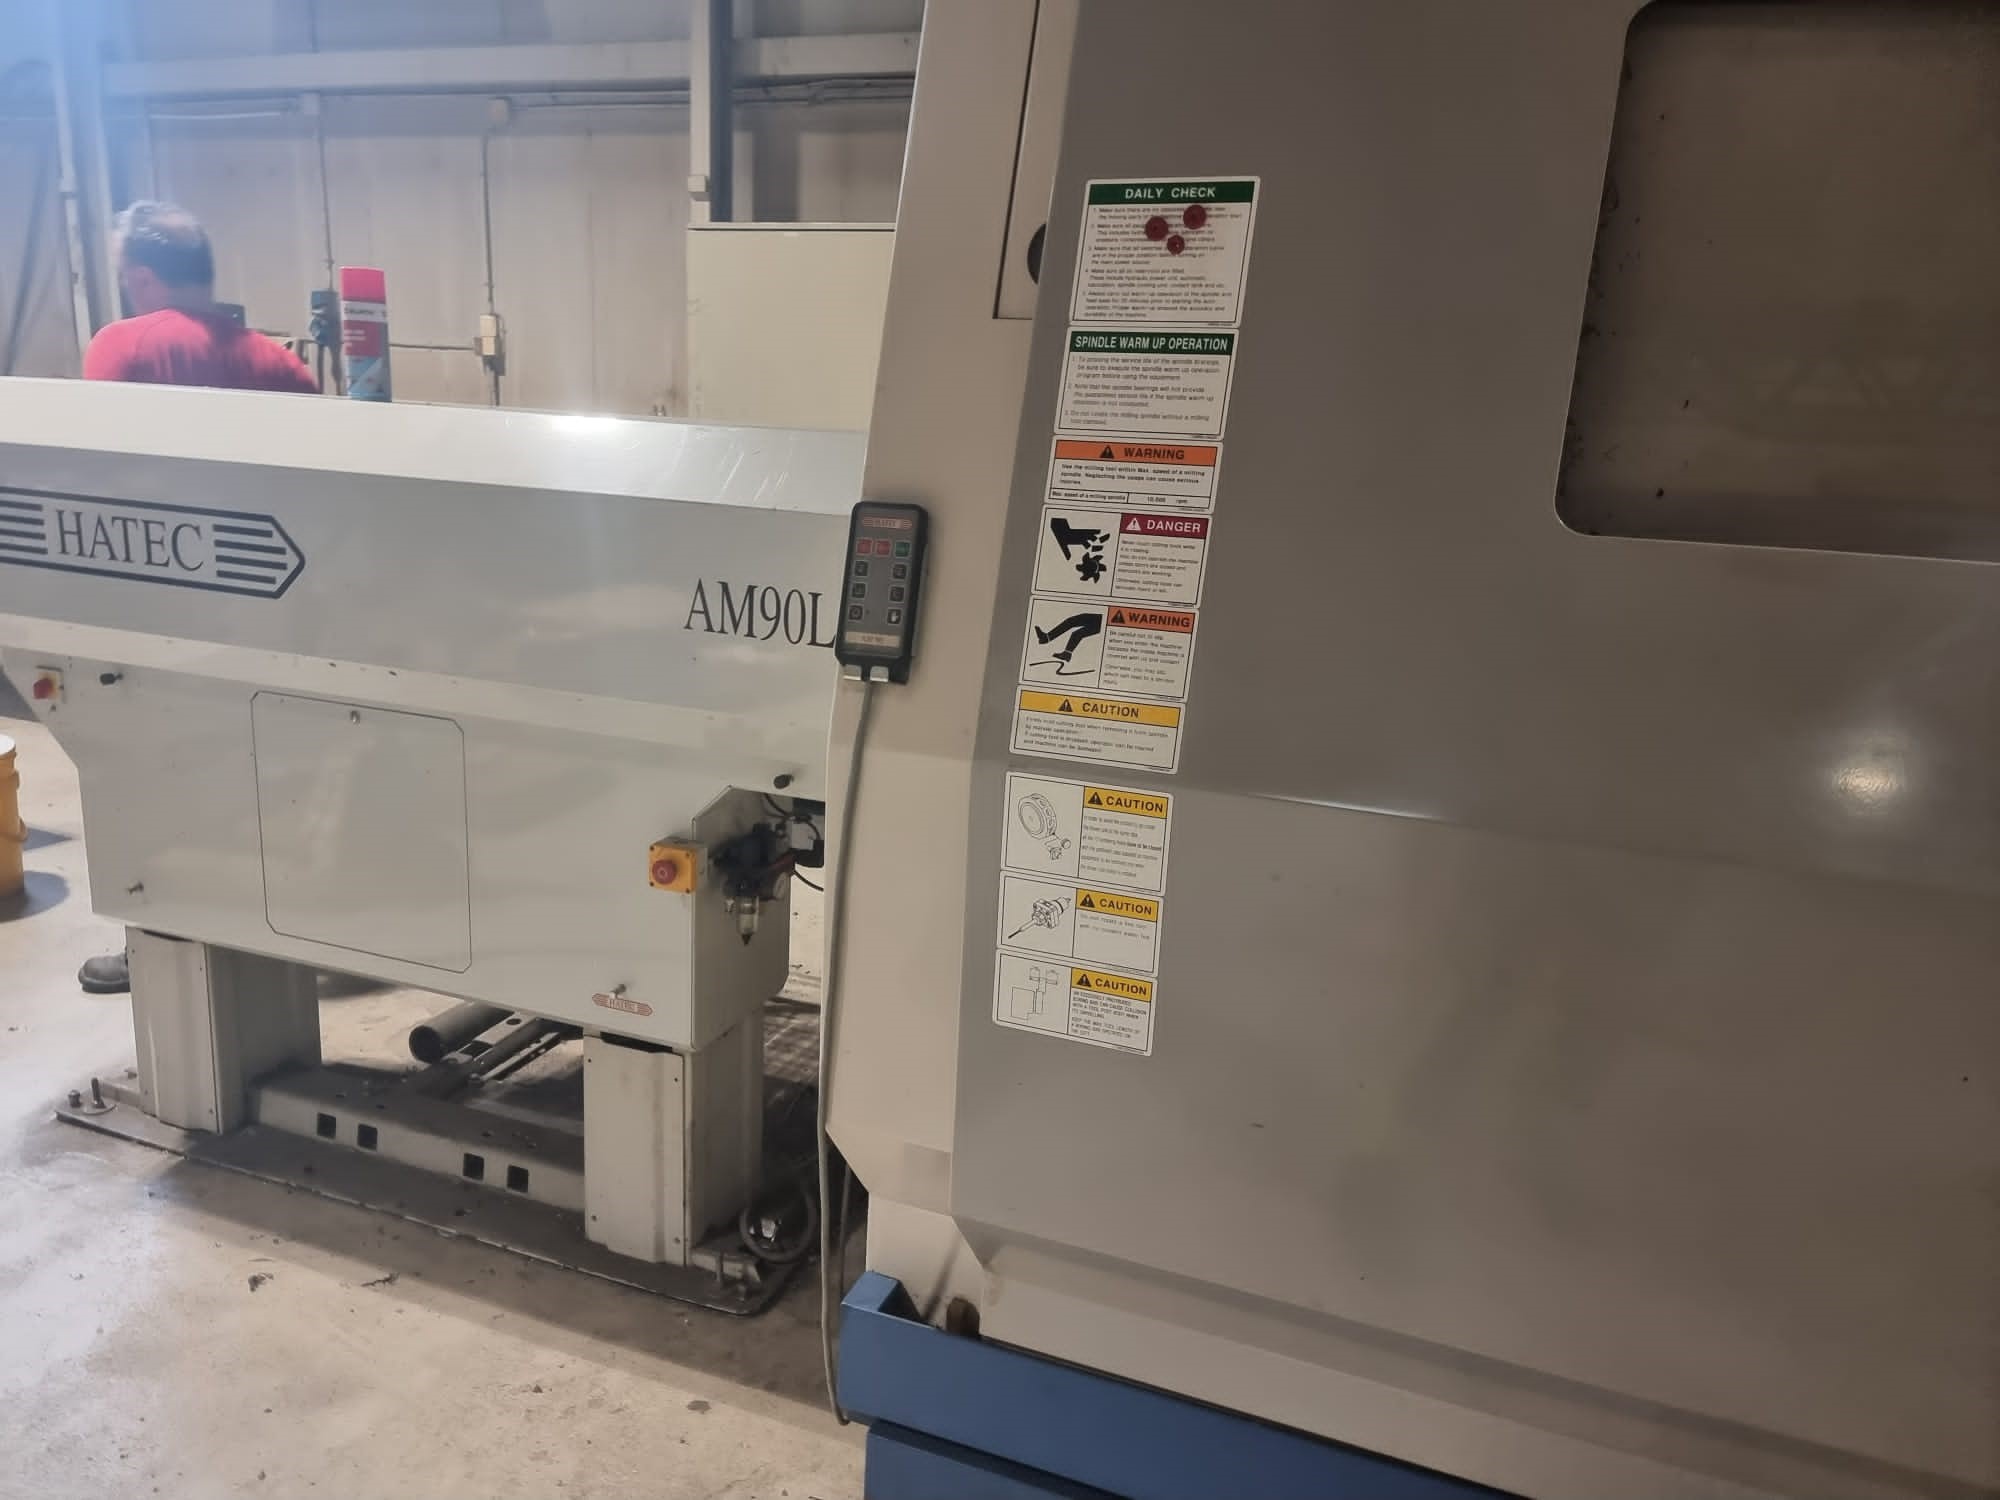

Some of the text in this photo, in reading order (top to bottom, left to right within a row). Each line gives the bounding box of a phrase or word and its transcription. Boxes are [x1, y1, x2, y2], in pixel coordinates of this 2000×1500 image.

[1125, 187, 1216, 199] DAILY CHECK
[1075, 336, 1227, 351] SPINDLE WARM UP OPERATION
[1124, 447, 1185, 460] WARNING
[1146, 520, 1201, 532] DANGER
[56, 509, 204, 571] HATEC
[683, 578, 836, 648] AM90L
[1128, 612, 1190, 627] WARNING
[1082, 702, 1139, 718] CAUTION
[1106, 796, 1163, 813] CAUTION
[1099, 899, 1152, 915] CAUTION
[1095, 978, 1147, 996] CAUTION
